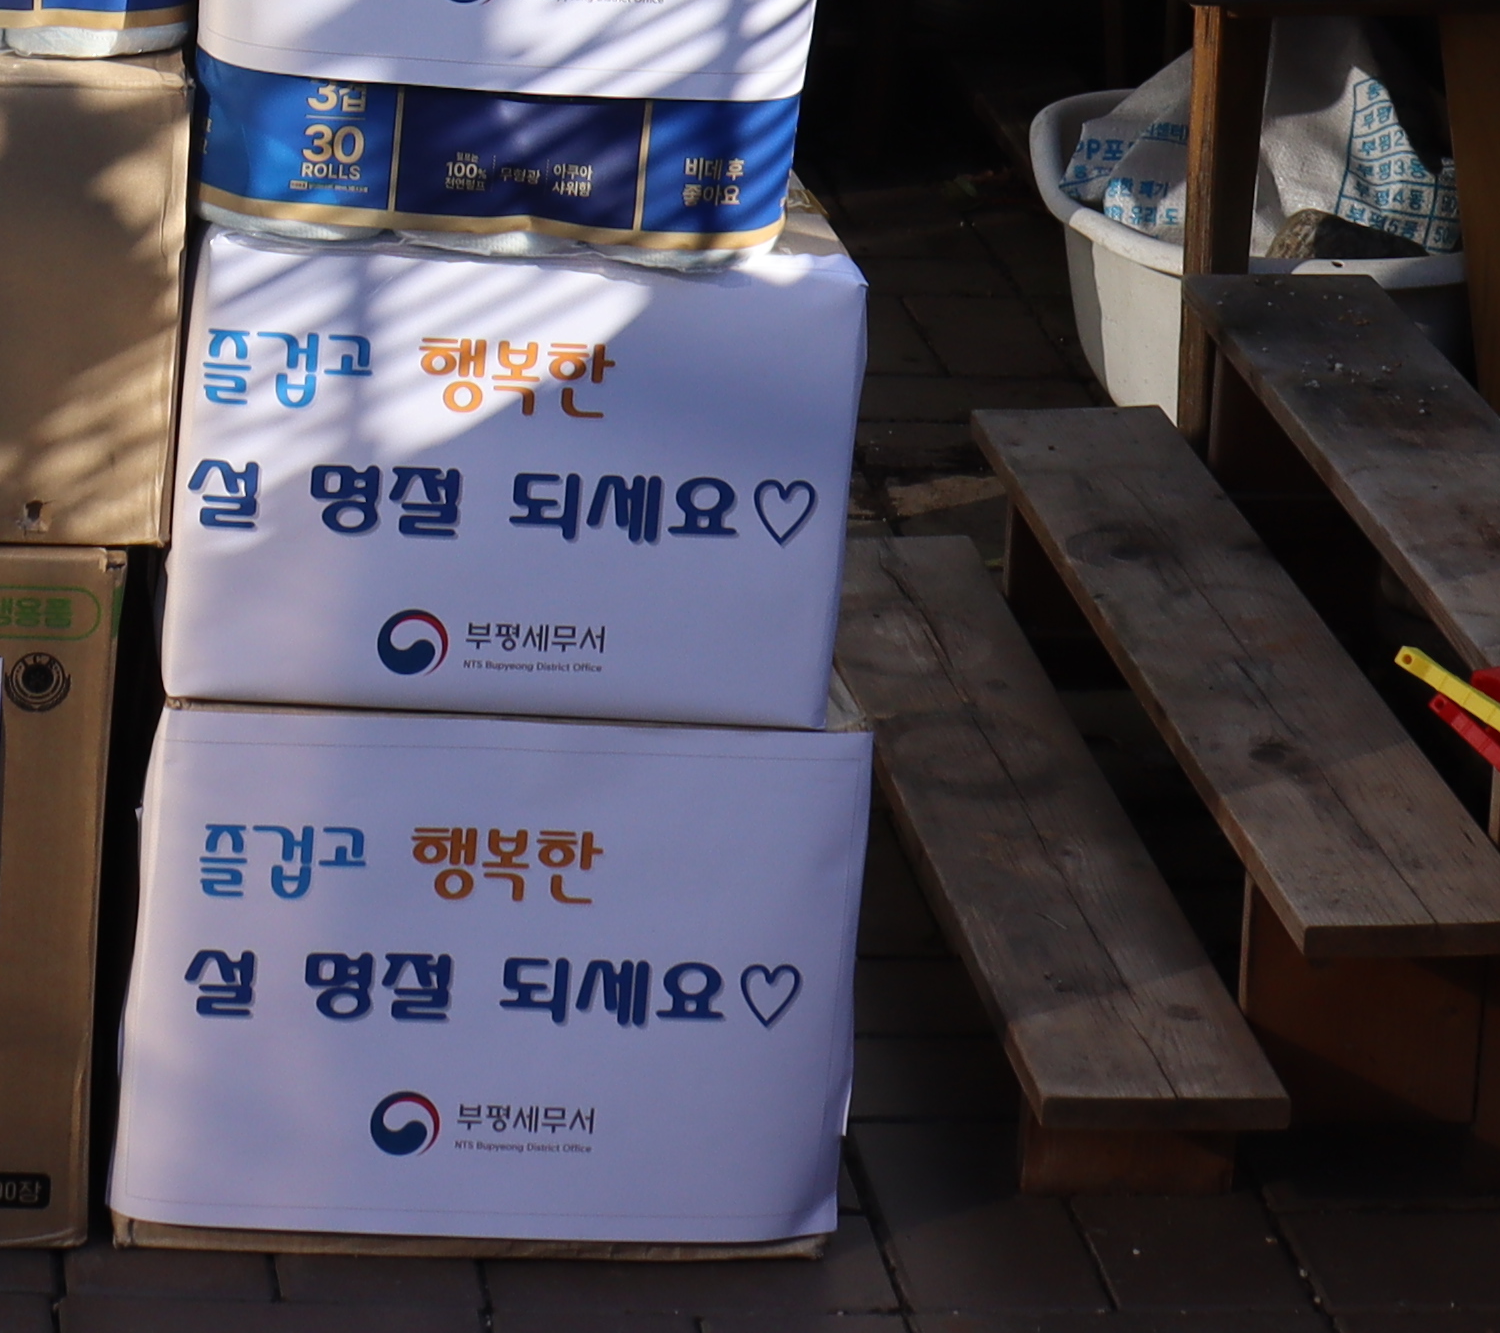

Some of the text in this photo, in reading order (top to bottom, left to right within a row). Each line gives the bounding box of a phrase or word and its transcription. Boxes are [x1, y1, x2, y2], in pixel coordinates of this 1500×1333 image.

[307, 78, 367, 113] 3겹
[302, 122, 364, 164] 30
[301, 162, 361, 181] ROLLS
[445, 160, 488, 180] 100%
[553, 162, 593, 182] 아쿠아
[683, 158, 744, 181] 비데 후
[1358, 158, 1427, 181] 부평3동
[682, 182, 740, 207] 좋아요
[203, 327, 616, 418] 즐겁고 행복한
[188, 458, 737, 544] 설 명절 되세요
[464, 622, 606, 655] 부평세무서
[463, 660, 603, 673] NTS Bupyeong District Office
[199, 823, 604, 904] 즐겁고 행복한
[184, 950, 724, 1027] 설 명절 되세요
[456, 1102, 596, 1136] 부평세무서
[454, 1140, 592, 1154] NTS Bupyeong District Office
